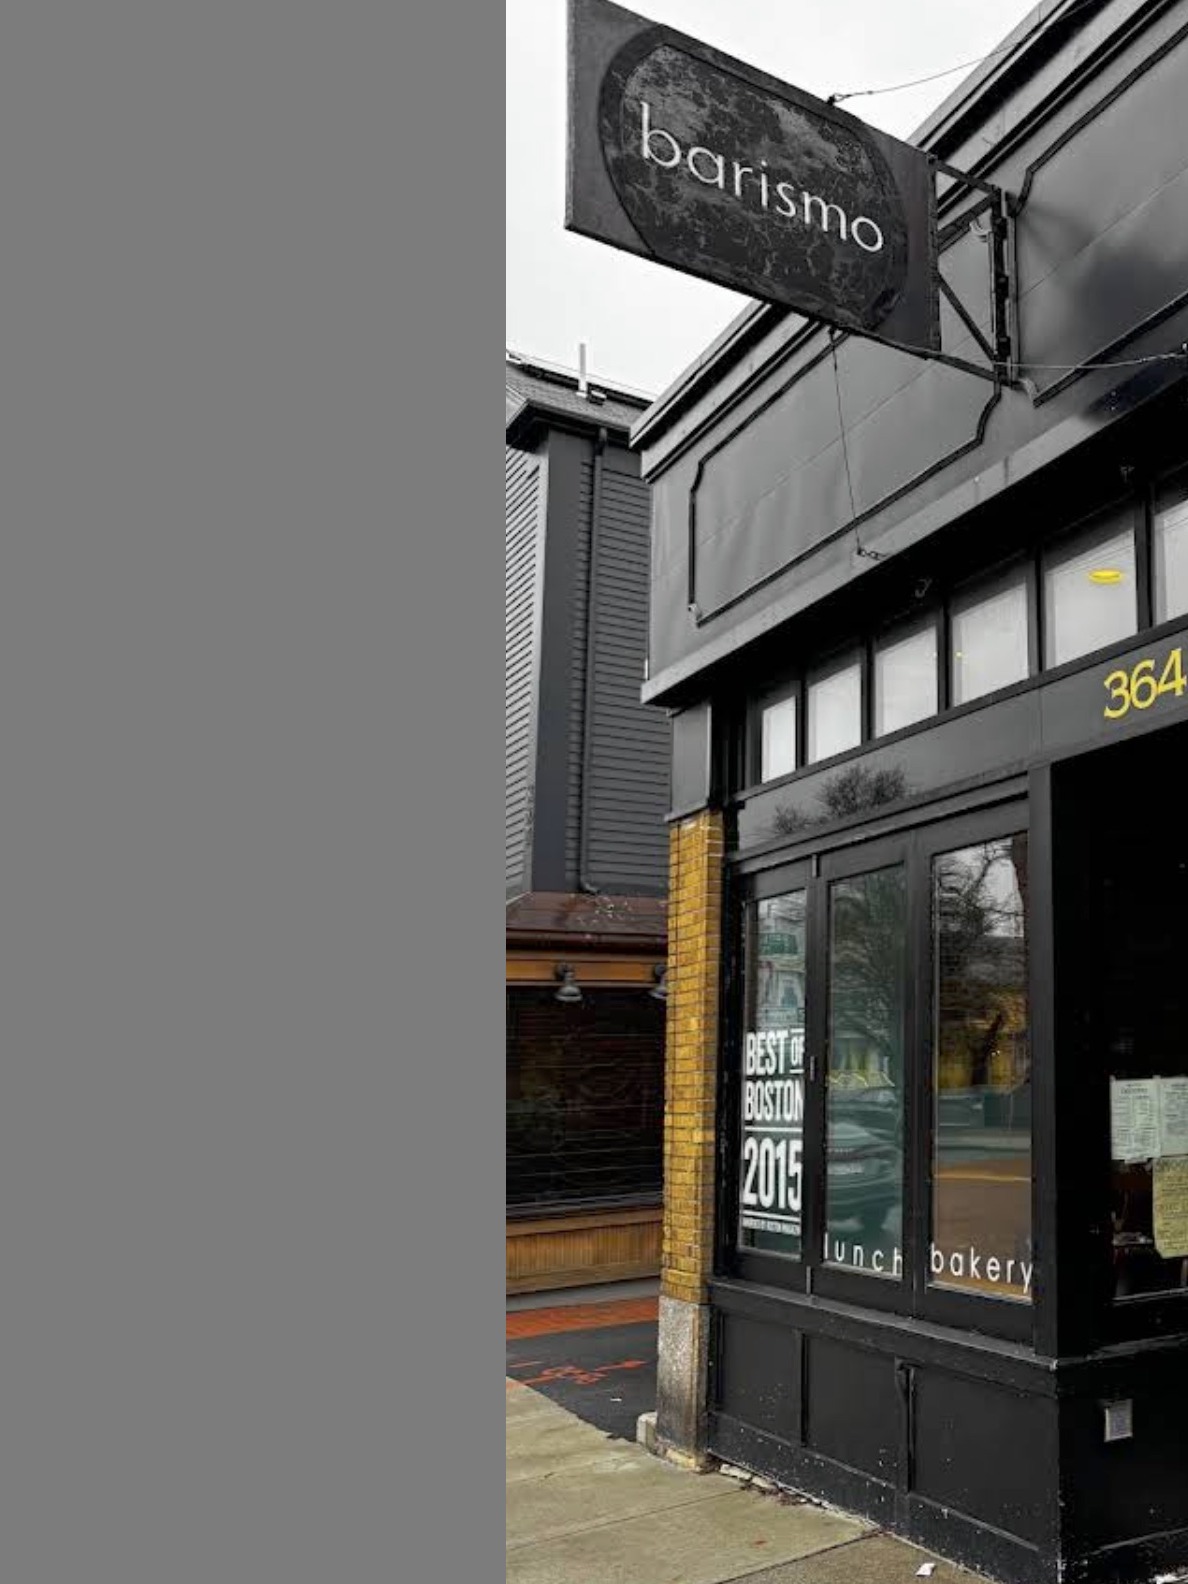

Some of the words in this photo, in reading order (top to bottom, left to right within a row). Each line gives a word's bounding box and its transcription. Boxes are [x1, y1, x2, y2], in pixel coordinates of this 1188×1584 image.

[640, 101, 884, 252] barismo
[1103, 647, 1188, 719] 364
[746, 1030, 789, 1075] BEST
[744, 1079, 804, 1121] BOSTON
[743, 1136, 804, 1212] 2015
[823, 1232, 903, 1276] lunch
[931, 1242, 1033, 1294] bakery
